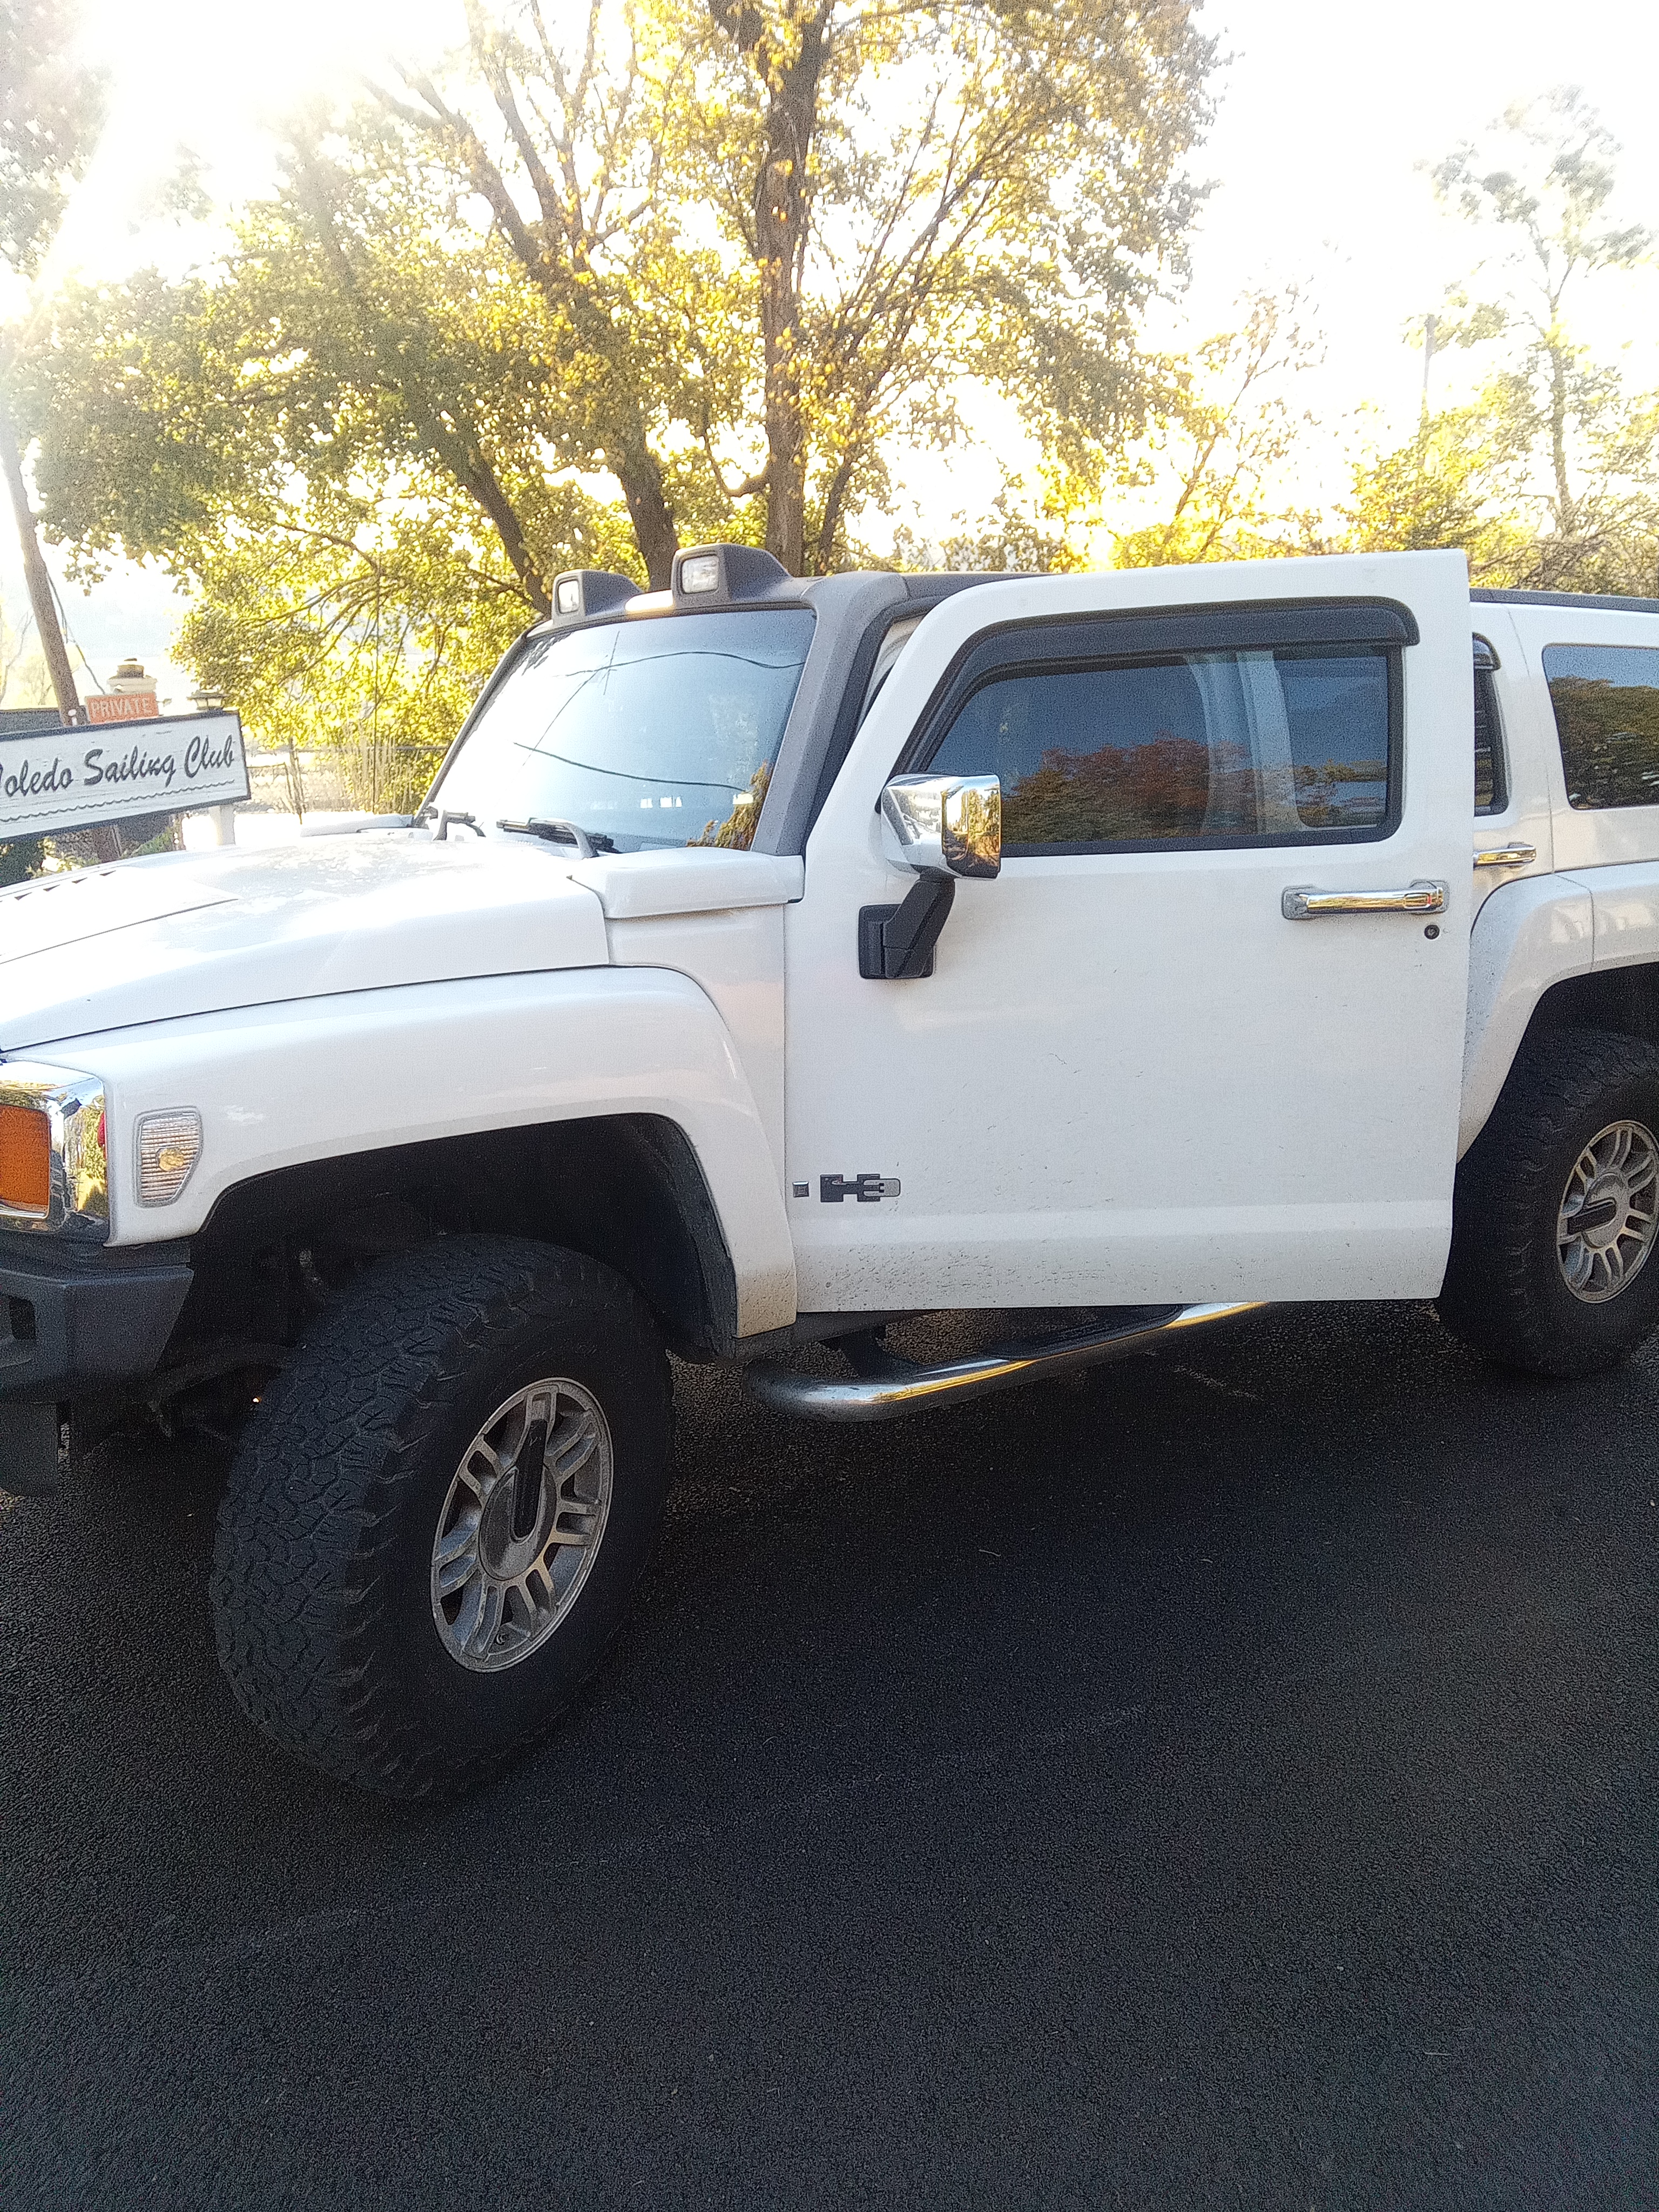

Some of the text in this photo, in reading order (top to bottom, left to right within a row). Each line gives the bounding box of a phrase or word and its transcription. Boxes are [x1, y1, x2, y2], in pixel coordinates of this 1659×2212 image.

[91, 698, 152, 718] PRIVATE
[0, 734, 234, 797] oledo Sailing Club
[820, 1174, 900, 1202] H3
